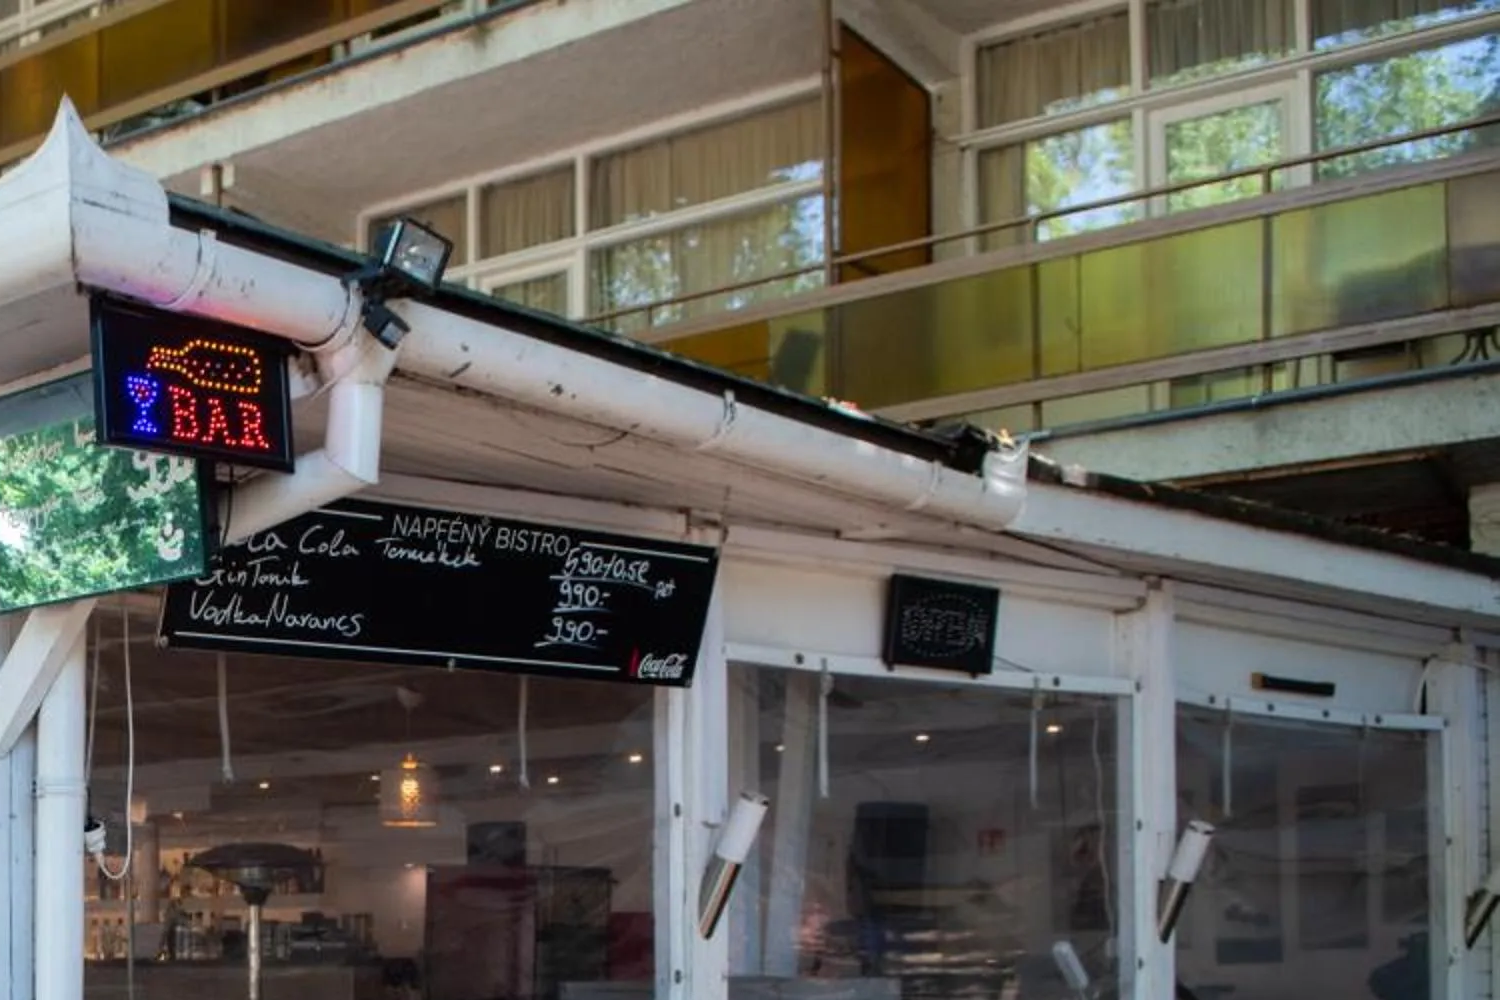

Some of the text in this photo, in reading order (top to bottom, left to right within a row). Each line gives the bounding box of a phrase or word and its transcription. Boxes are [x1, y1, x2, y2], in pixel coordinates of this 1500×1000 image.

[168, 385, 270, 449] BAR
[299, 525, 359, 557] Cola
[393, 513, 571, 557] NAPFÉNY BISTRO
